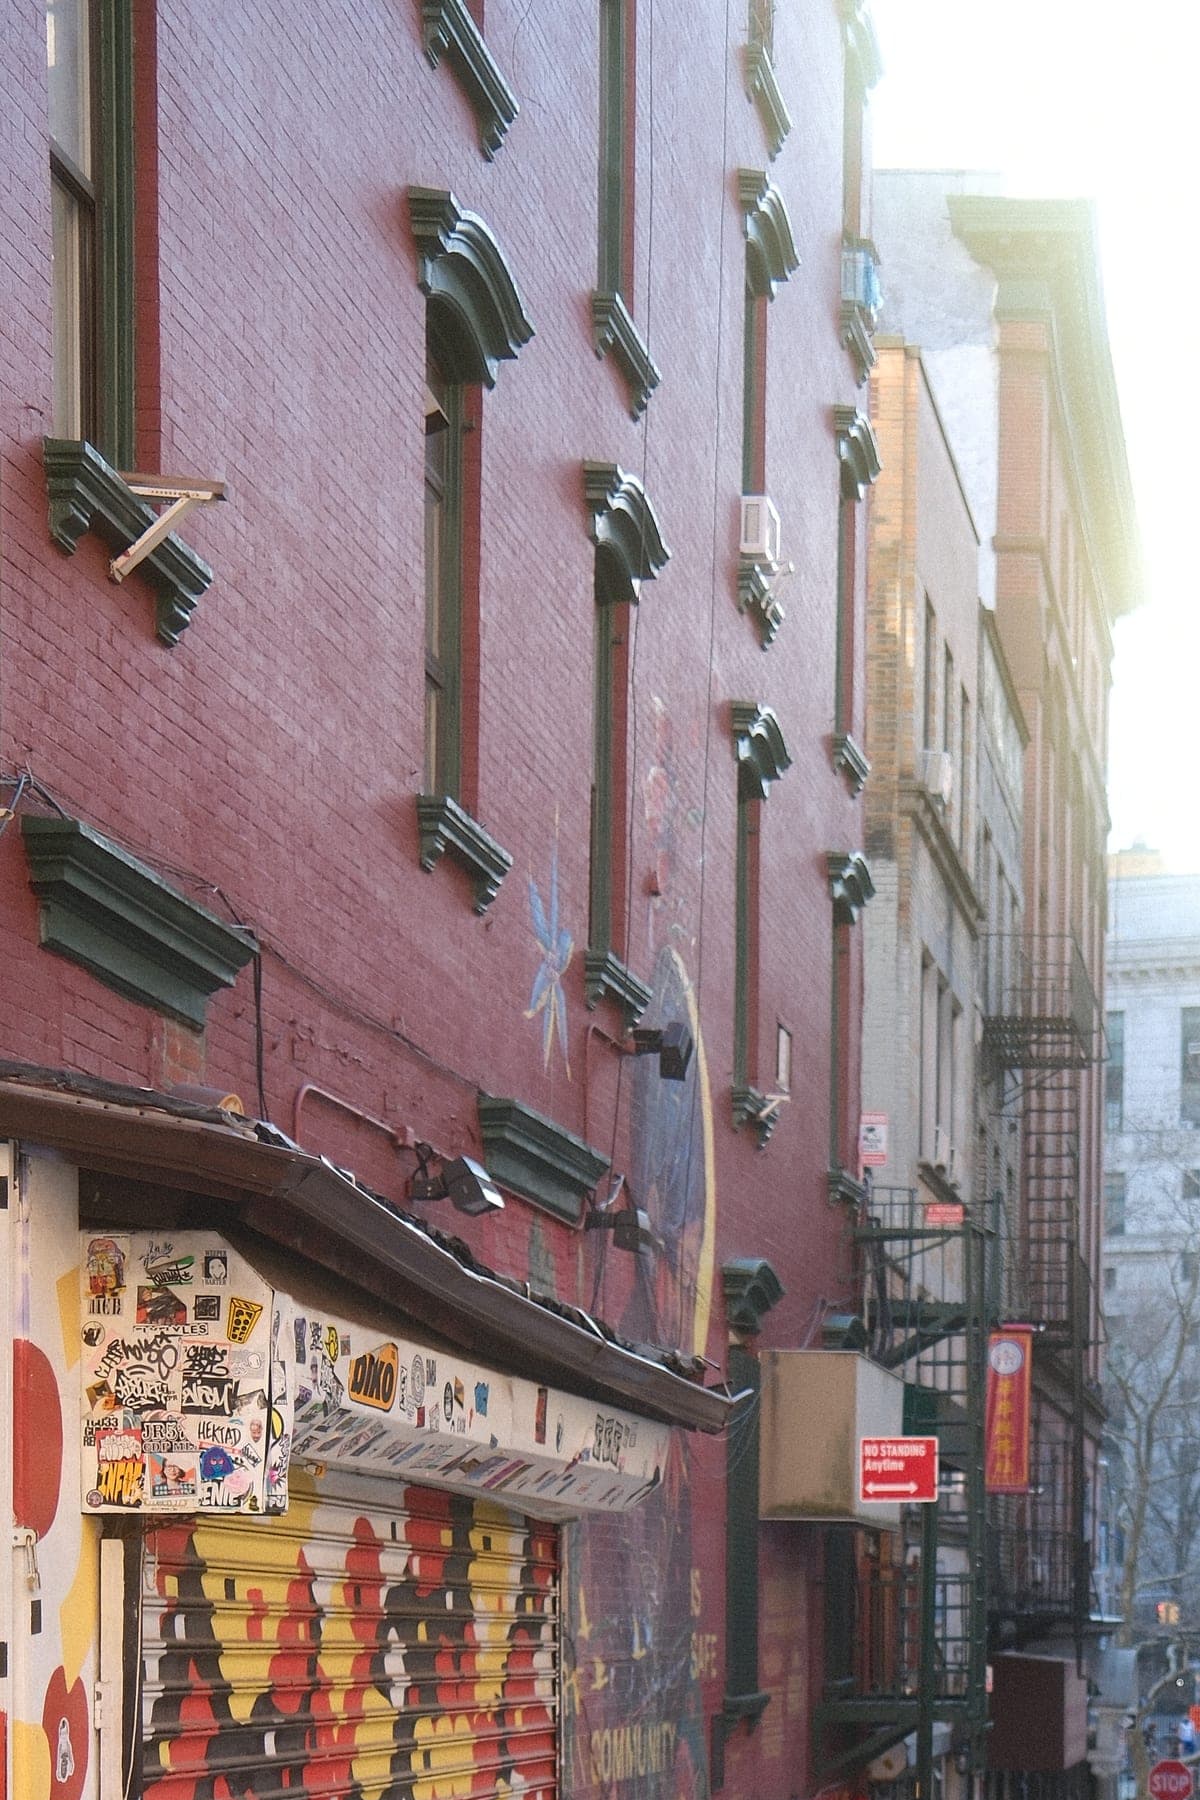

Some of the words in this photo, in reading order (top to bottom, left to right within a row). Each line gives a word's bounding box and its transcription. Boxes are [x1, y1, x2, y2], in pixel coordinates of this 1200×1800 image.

[864, 1444, 879, 1457] NO
[880, 1443, 926, 1457] STANDING
[864, 1458, 905, 1474] Anytime
[1151, 1775, 1189, 1793] STOP
